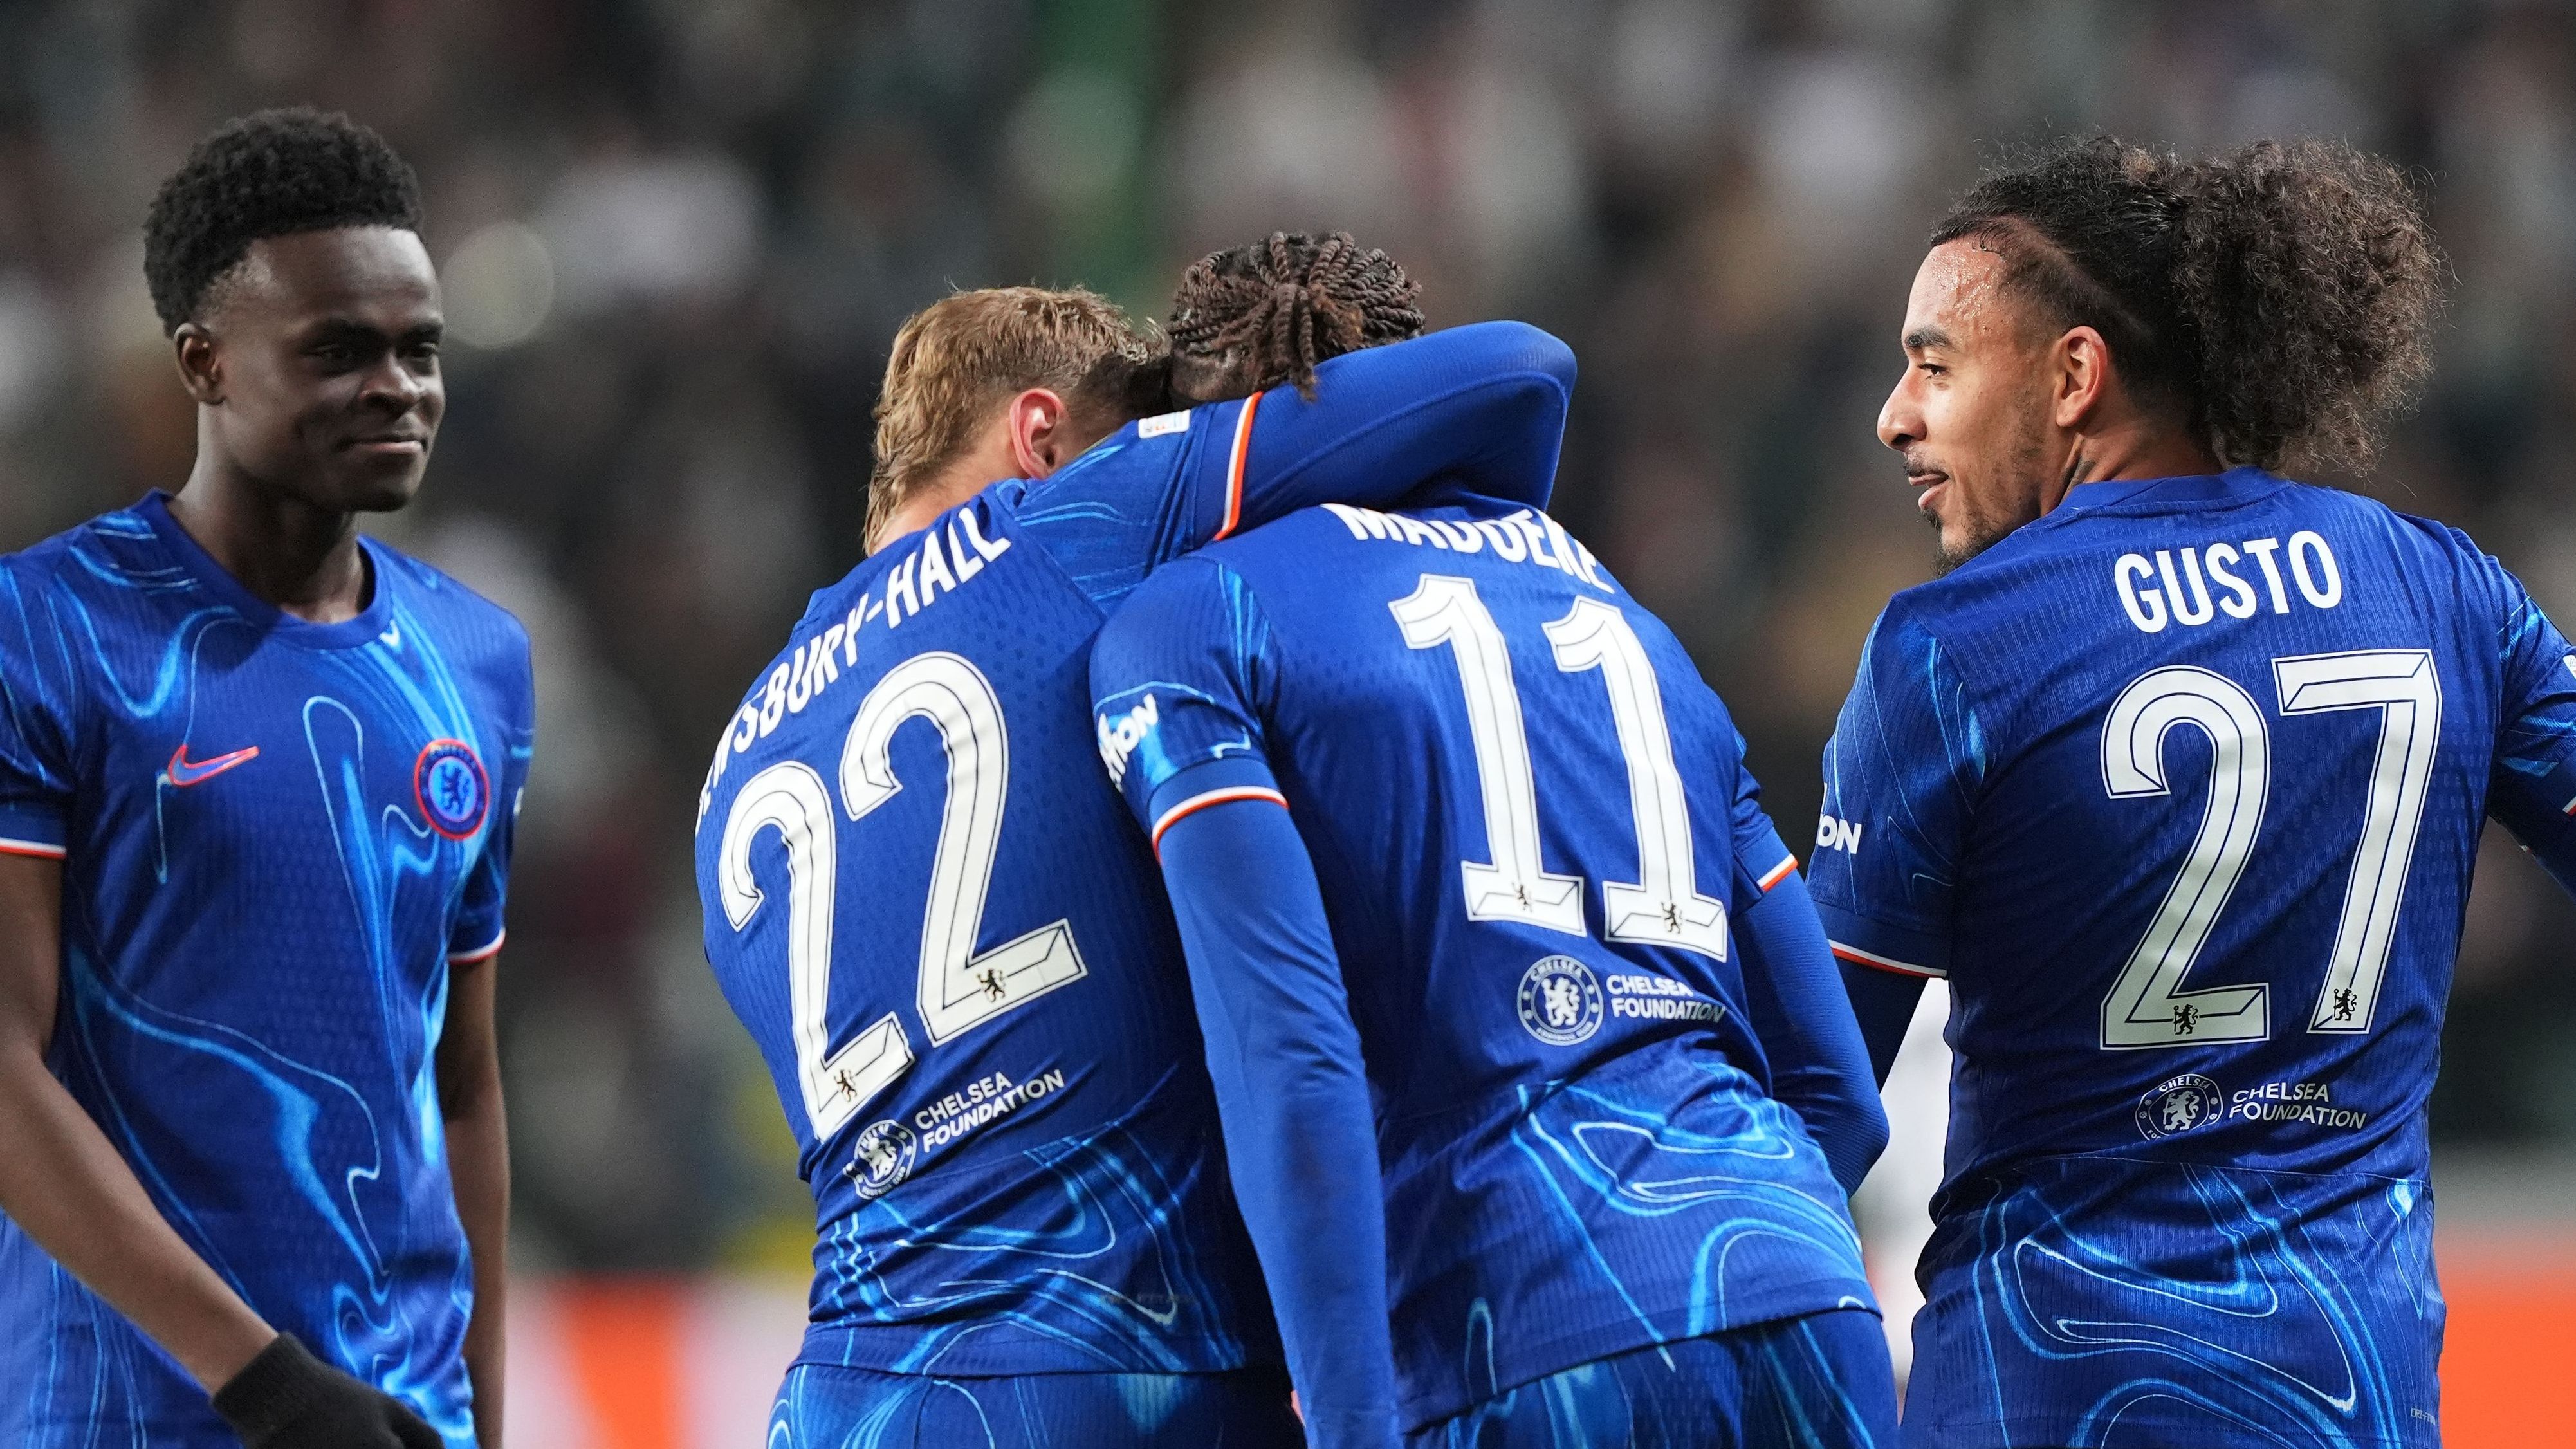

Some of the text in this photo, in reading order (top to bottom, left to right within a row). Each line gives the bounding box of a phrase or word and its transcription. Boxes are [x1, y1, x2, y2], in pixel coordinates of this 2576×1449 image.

[2114, 530, 2342, 633] GUSTO
[1388, 573, 1727, 963] 11
[2099, 649, 2443, 1051] 27
[718, 651, 1089, 1143] 22
[1606, 974, 1693, 997] CHELSEA
[1610, 998, 1727, 1023] FOUNDATION
[915, 1071, 1012, 1131] CHELSEA
[922, 1068, 1065, 1154] FOUNDATION
[2158, 1076, 2212, 1093] CHELSEA
[2232, 1082, 2330, 1103] CHELSEA
[2229, 1102, 2368, 1129] FOUNDATION
